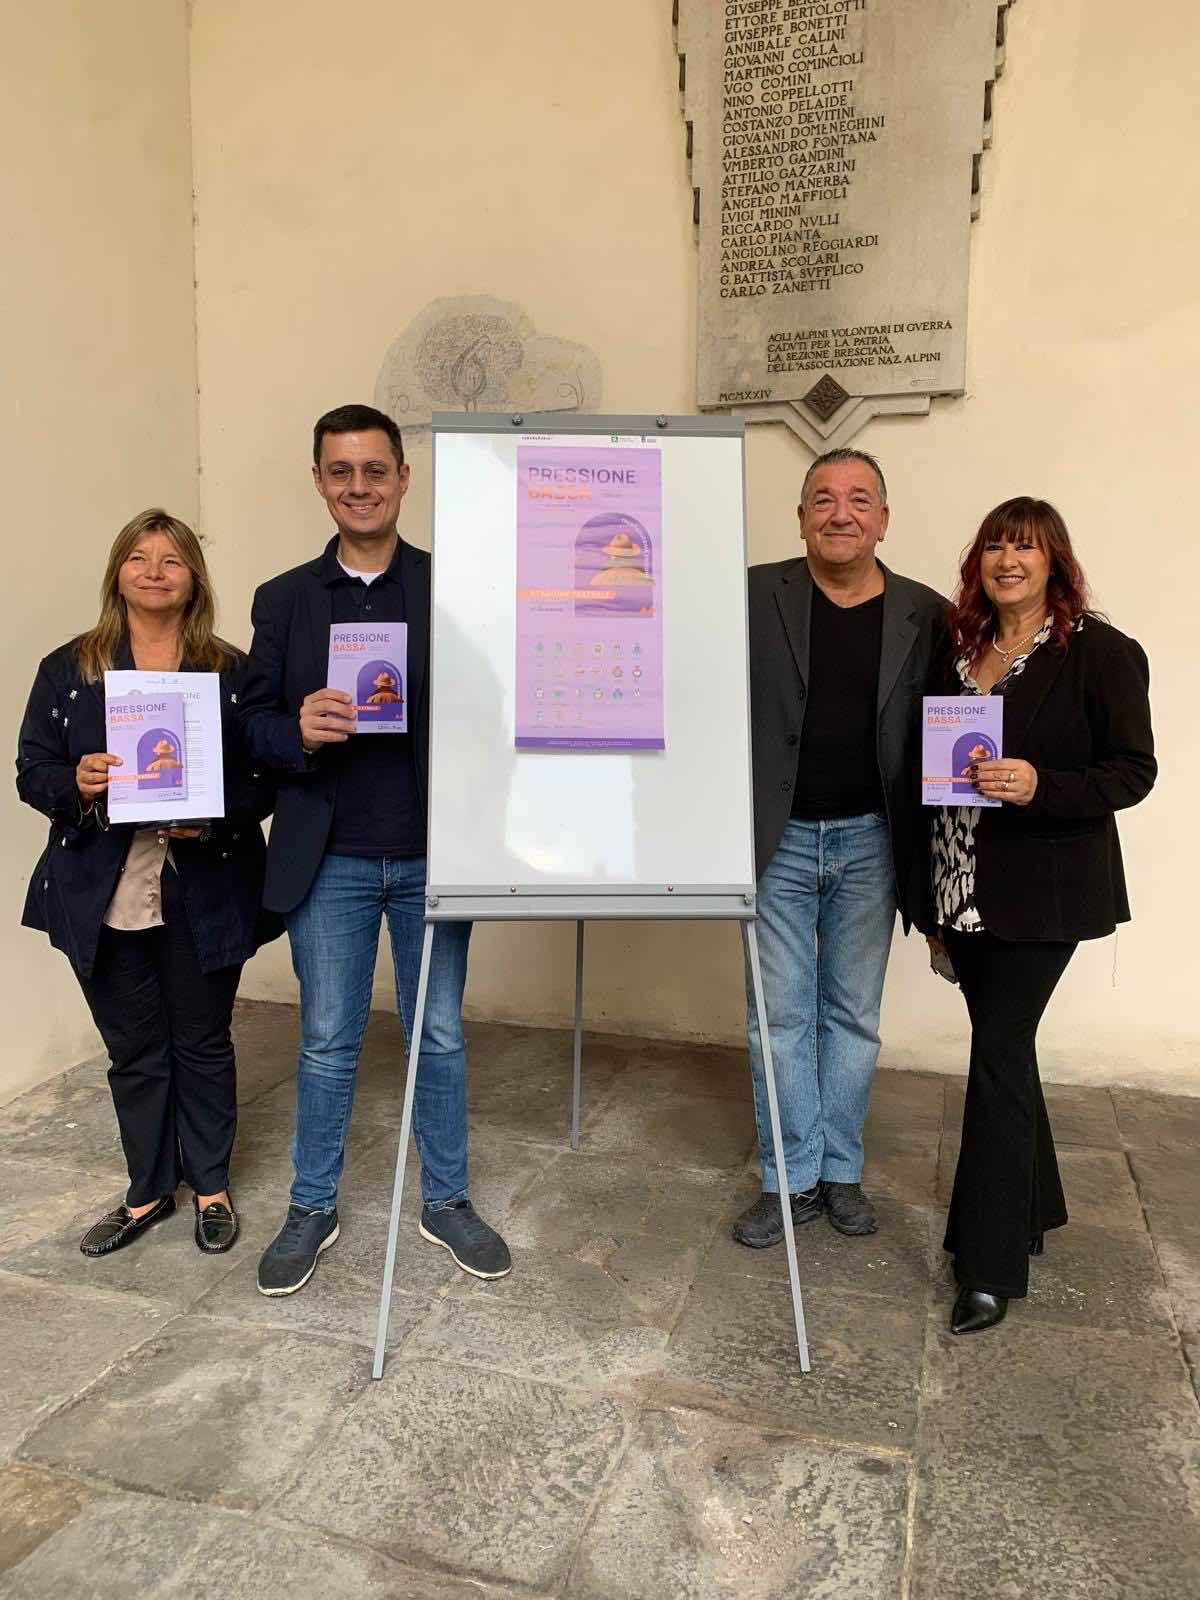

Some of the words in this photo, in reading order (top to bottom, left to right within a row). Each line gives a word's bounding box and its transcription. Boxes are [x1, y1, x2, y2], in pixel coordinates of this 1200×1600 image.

[725, 0, 784, 16] GIVSEPPE
[725, 12, 777, 30] ETTORE
[783, 0, 866, 21] BERTOLOTTI
[724, 24, 784, 43] GIVSEPPE
[790, 14, 848, 33] BONETTI
[724, 37, 791, 56] ANNIBALE
[798, 28, 845, 45] CALINI
[724, 50, 784, 69] GIOVANNI
[792, 43, 838, 59] COLLA
[724, 64, 784, 82] MARTINO
[788, 52, 864, 73] COMINCIOLI
[723, 95, 754, 109] NINO
[761, 80, 853, 103] COPPELLOTTI
[724, 82, 753, 94] VGO
[761, 73, 811, 89] COMINI
[723, 104, 783, 121] ANTONIO
[790, 95, 848, 112] DELAIDE
[723, 115, 792, 133] COSTANZO
[798, 107, 855, 124] DEVITINI
[722, 129, 785, 147] GIOVANNI
[791, 116, 885, 139] DOMENEGHINI
[723, 139, 808, 160] ALESSANDRO
[813, 131, 877, 148] FONTANA
[722, 155, 784, 172] VMBERTO
[789, 147, 844, 165] GANDINI
[722, 170, 774, 186] ATTILIO
[779, 160, 856, 179] GAZZARINI
[721, 182, 780, 199] STEFANO
[785, 174, 850, 192] MANERBA
[721, 196, 775, 211] ANGELO
[780, 187, 847, 204] MAFFIOLI
[721, 210, 754, 224] LVIGI
[760, 205, 801, 220] MININI
[721, 219, 793, 236] RICCARDO
[799, 213, 840, 228] NVLLI
[720, 234, 766, 249] CARLO
[770, 229, 821, 244] PIANTA
[720, 244, 797, 260] ANGIOLINO
[803, 235, 879, 252] REGGIARDI
[720, 259, 775, 273] ANDREA
[781, 252, 839, 268] SCOLARI
[720, 285, 766, 298] CARLO
[772, 279, 831, 294] ZANETTI
[768, 333, 793, 343] AGLI
[795, 330, 829, 341] ALPINI
[831, 325, 891, 338] VOLONTARI
[893, 324, 904, 334] DI
[906, 320, 952, 332] GVERRA
[767, 353, 782, 363] LA
[786, 350, 829, 360] SEZIONE
[834, 345, 895, 358] BRESCIANA
[768, 342, 807, 353] CADVTI
[811, 340, 830, 350] PER
[834, 339, 850, 348] LA
[853, 335, 890, 347] PATRIA
[905, 352, 941, 364] ALPINI
[719, 389, 773, 402] MCMXXIV
[528, 466, 637, 485] PRESSIONE
[334, 633, 391, 643] PRESSIONE
[334, 643, 367, 652] BASSA
[110, 702, 168, 714] PRESSIONE
[111, 713, 144, 724] BASSA
[928, 706, 987, 715] PRESSIONE
[928, 716, 960, 725] BASSA
